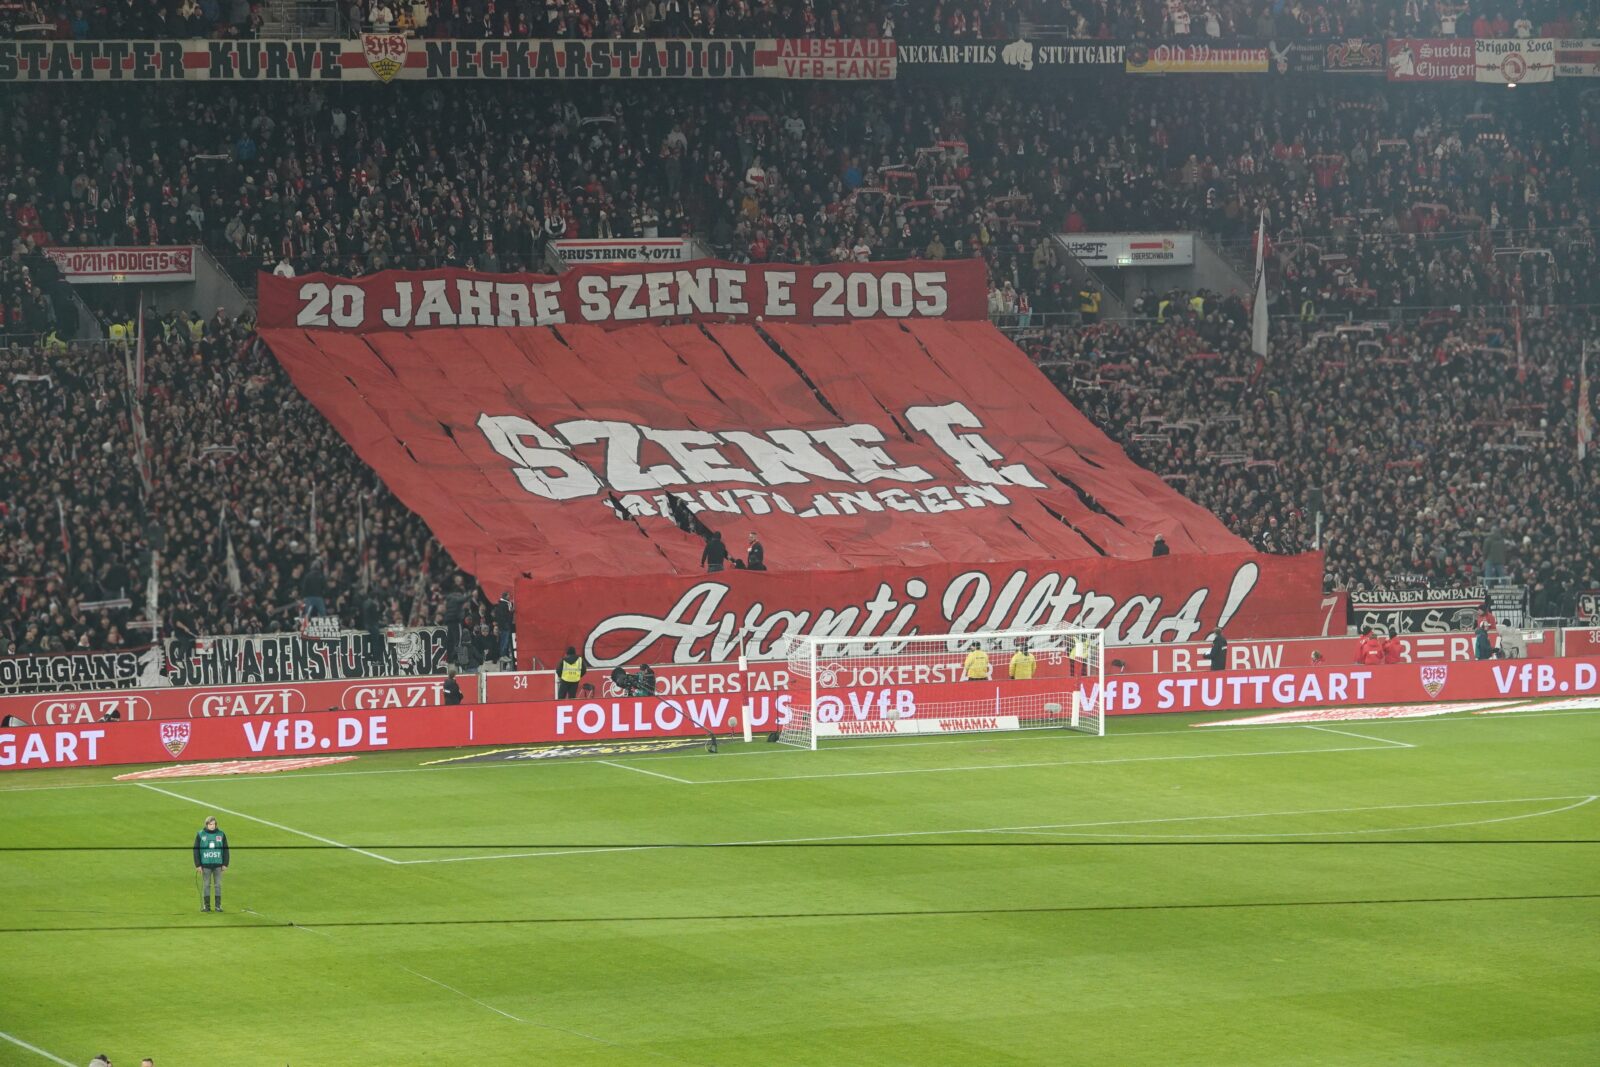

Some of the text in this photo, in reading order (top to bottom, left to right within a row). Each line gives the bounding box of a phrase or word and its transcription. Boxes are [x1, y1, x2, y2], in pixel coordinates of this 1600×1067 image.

[781, 39, 893, 57] ALBSTADT
[899, 45, 1126, 64] NECKAR-FILS STUTTGART
[1153, 43, 1187, 66] Old
[1190, 43, 1267, 66] Warriors
[1420, 43, 1471, 58] Suebia
[1476, 40, 1553, 55] Brigada Loca
[209, 41, 341, 79] KURVE
[425, 40, 756, 78] NECKARSTADION
[784, 58, 892, 78] VFB-FANS
[559, 247, 681, 260] BRUSTRING 0711
[297, 268, 947, 328] 20 JAHRE SZENE E 2005
[475, 400, 1048, 500] SZENE E
[1350, 590, 1424, 604] SCHWABEN
[1427, 586, 1486, 600] KOMPANIE
[584, 562, 1259, 667] Avanti Ultras!
[1048, 652, 1063, 666] 35
[513, 675, 528, 690] 34
[1081, 671, 1372, 711] VfB STUTTGART
[556, 689, 917, 735] FOLLOW US @VfB
[838, 720, 897, 734] WINAMAX
[939, 716, 999, 731] WINAMAX
[242, 715, 388, 752] VfB.DE
[0, 730, 105, 765] GART
[203, 851, 220, 859] HOST
